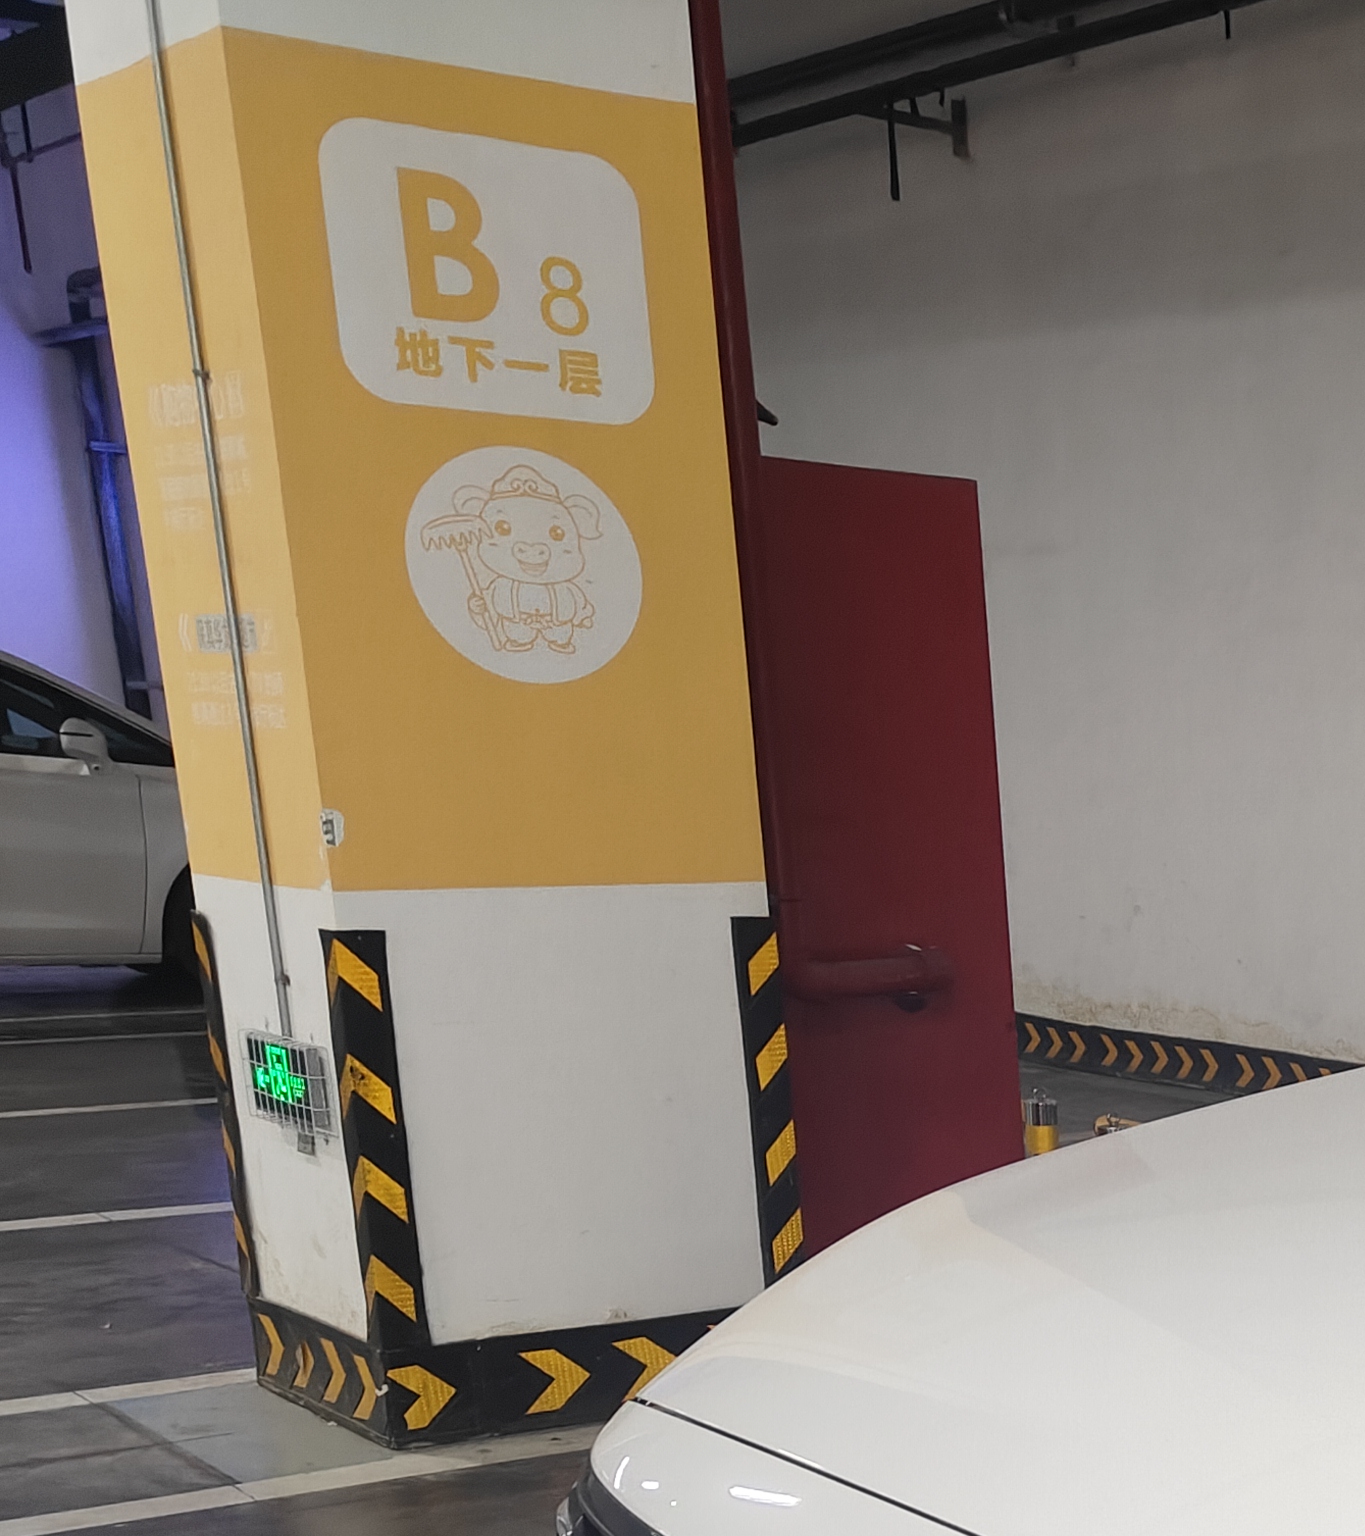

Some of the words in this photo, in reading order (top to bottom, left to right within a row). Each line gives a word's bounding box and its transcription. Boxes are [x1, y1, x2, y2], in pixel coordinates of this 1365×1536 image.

[396, 166, 500, 323] B
[539, 256, 589, 336] 8
[394, 326, 602, 397] 地下一层
